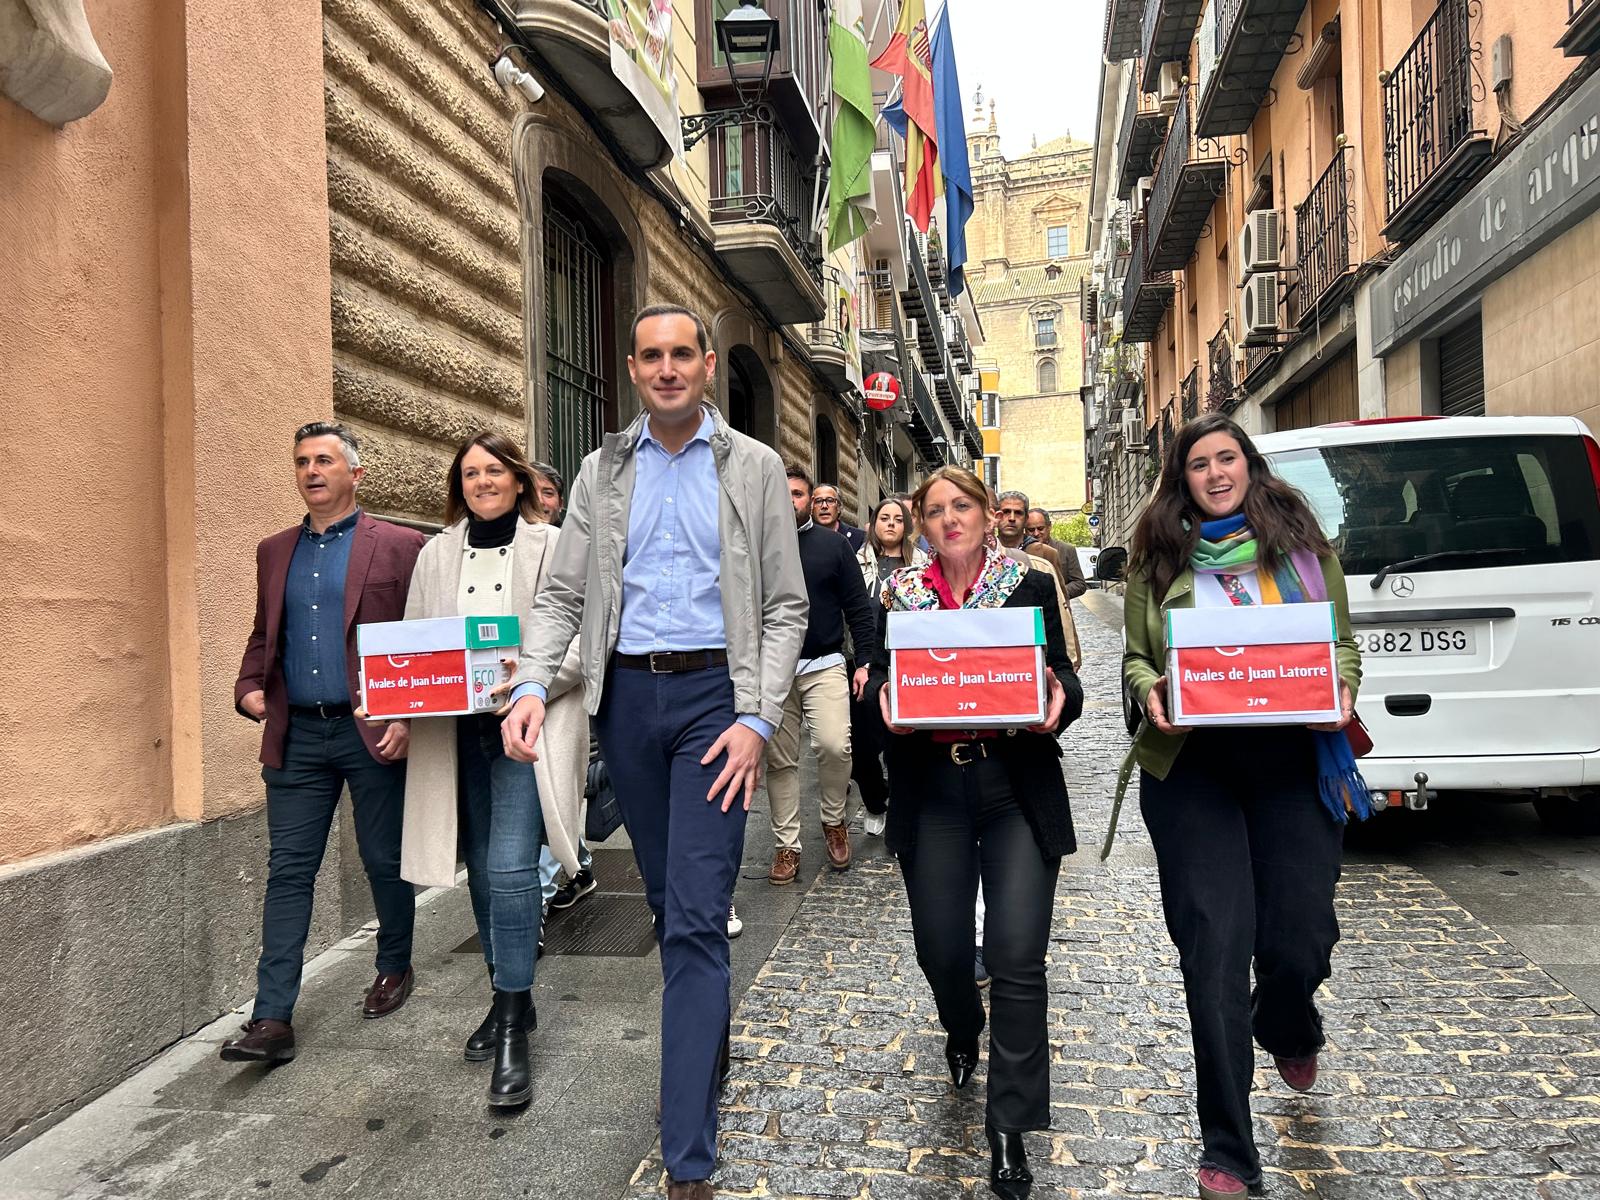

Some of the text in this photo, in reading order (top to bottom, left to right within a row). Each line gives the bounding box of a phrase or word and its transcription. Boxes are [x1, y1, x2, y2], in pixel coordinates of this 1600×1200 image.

[1394, 234, 1461, 313] estudio
[1479, 194, 1506, 242] de
[1353, 630, 1466, 653] 2882 DSG
[369, 674, 464, 689] Avales de Juan Latorre
[474, 670, 495, 686] ECO
[901, 670, 1032, 687] Avales de Juan Latorre
[1184, 665, 1328, 683] Avales de Juan Latorre
